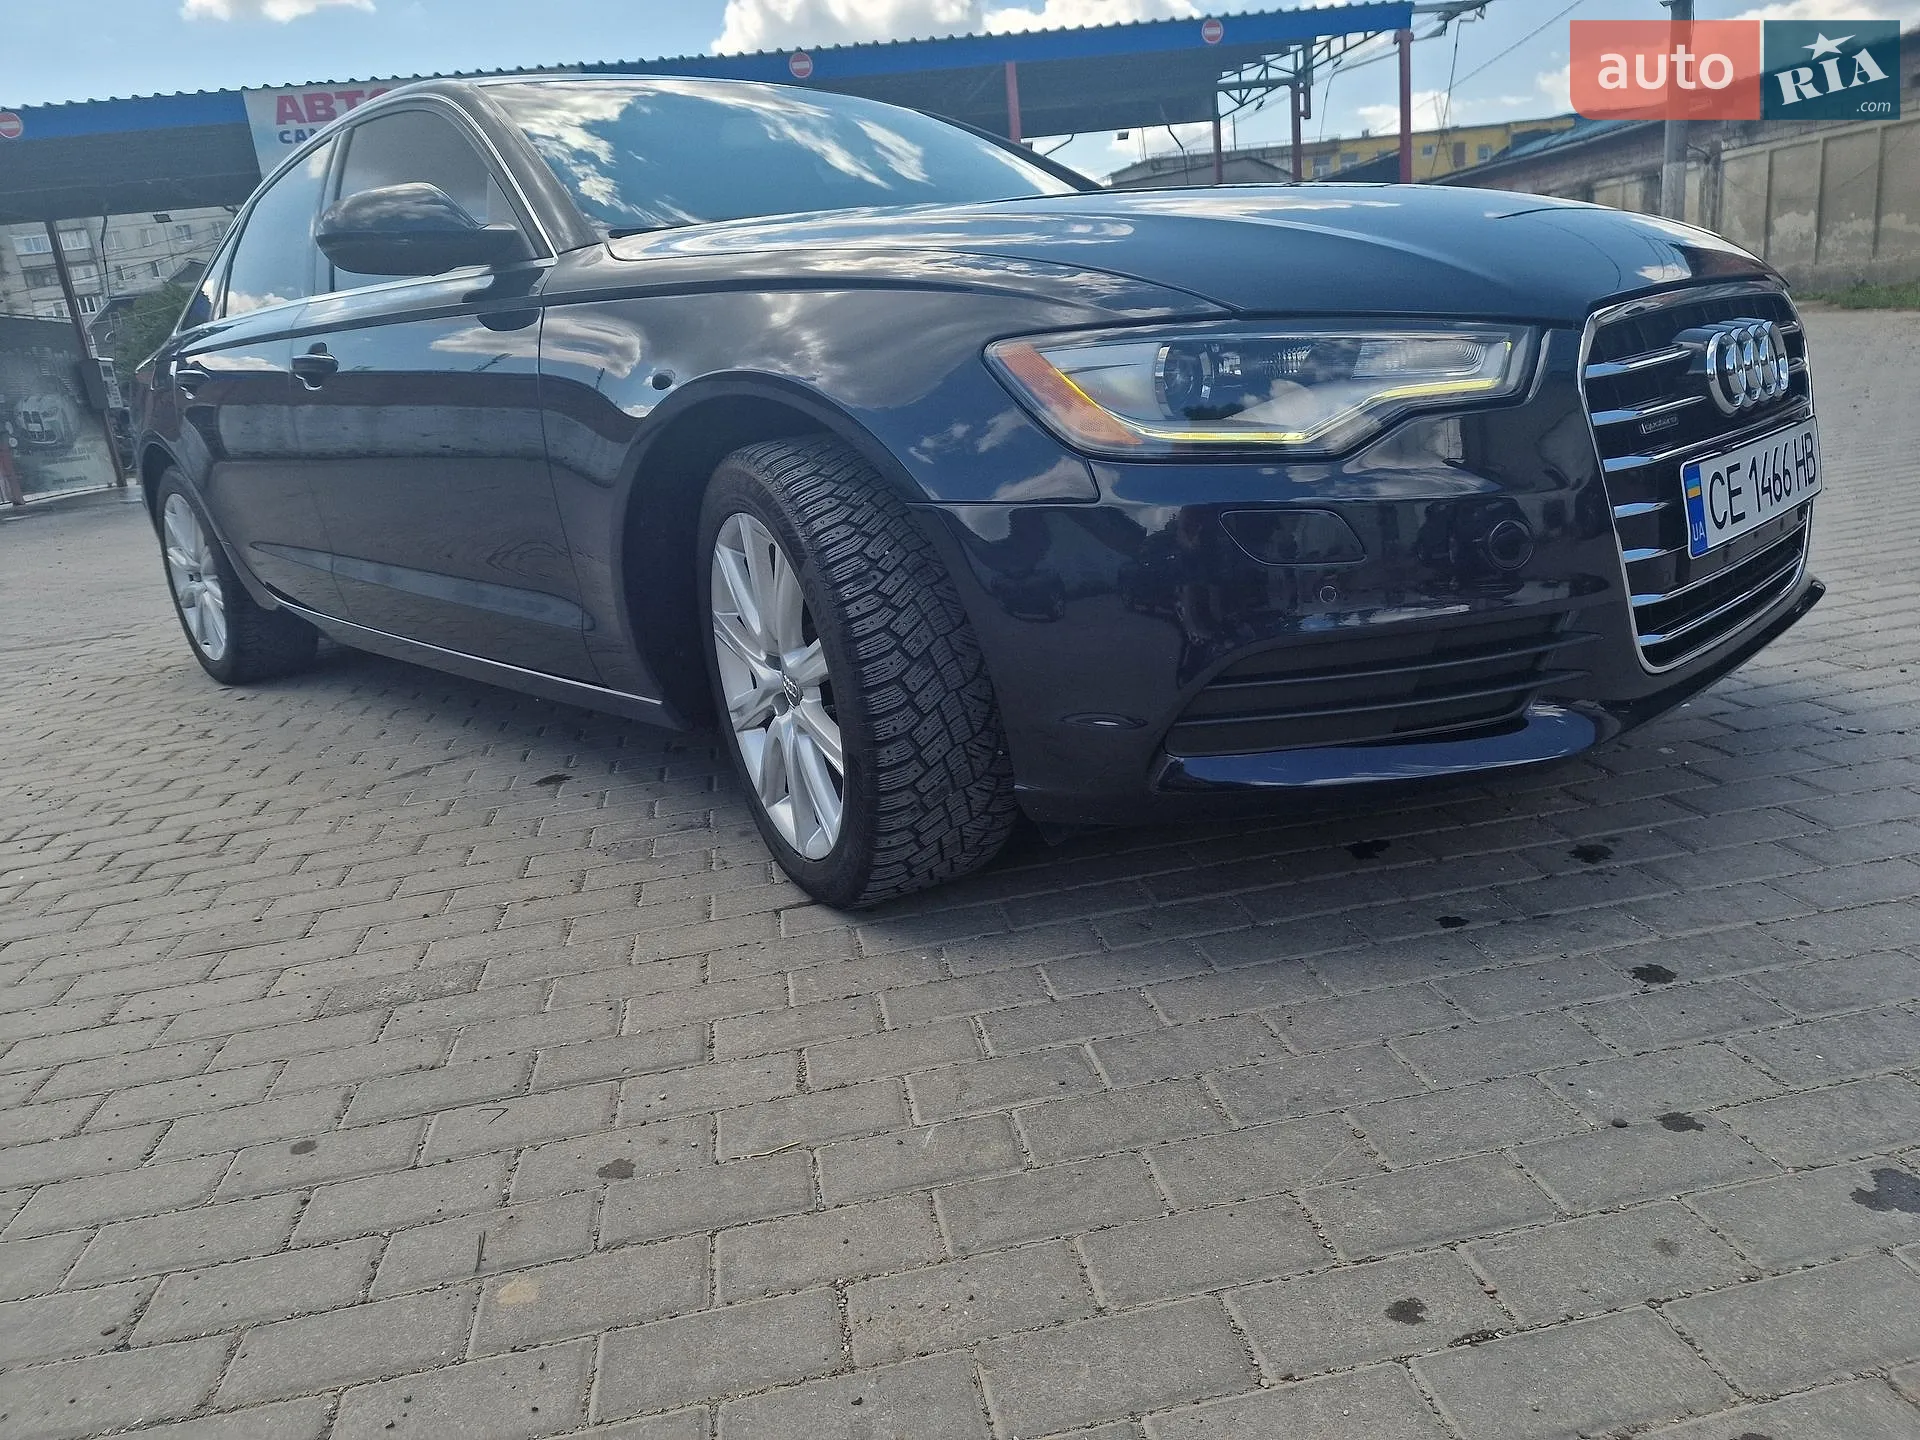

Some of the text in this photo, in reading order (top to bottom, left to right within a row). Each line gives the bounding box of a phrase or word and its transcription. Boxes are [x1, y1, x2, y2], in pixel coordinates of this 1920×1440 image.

[1709, 431, 1816, 530] CE 1466 HB
[1692, 521, 1706, 542] UA
